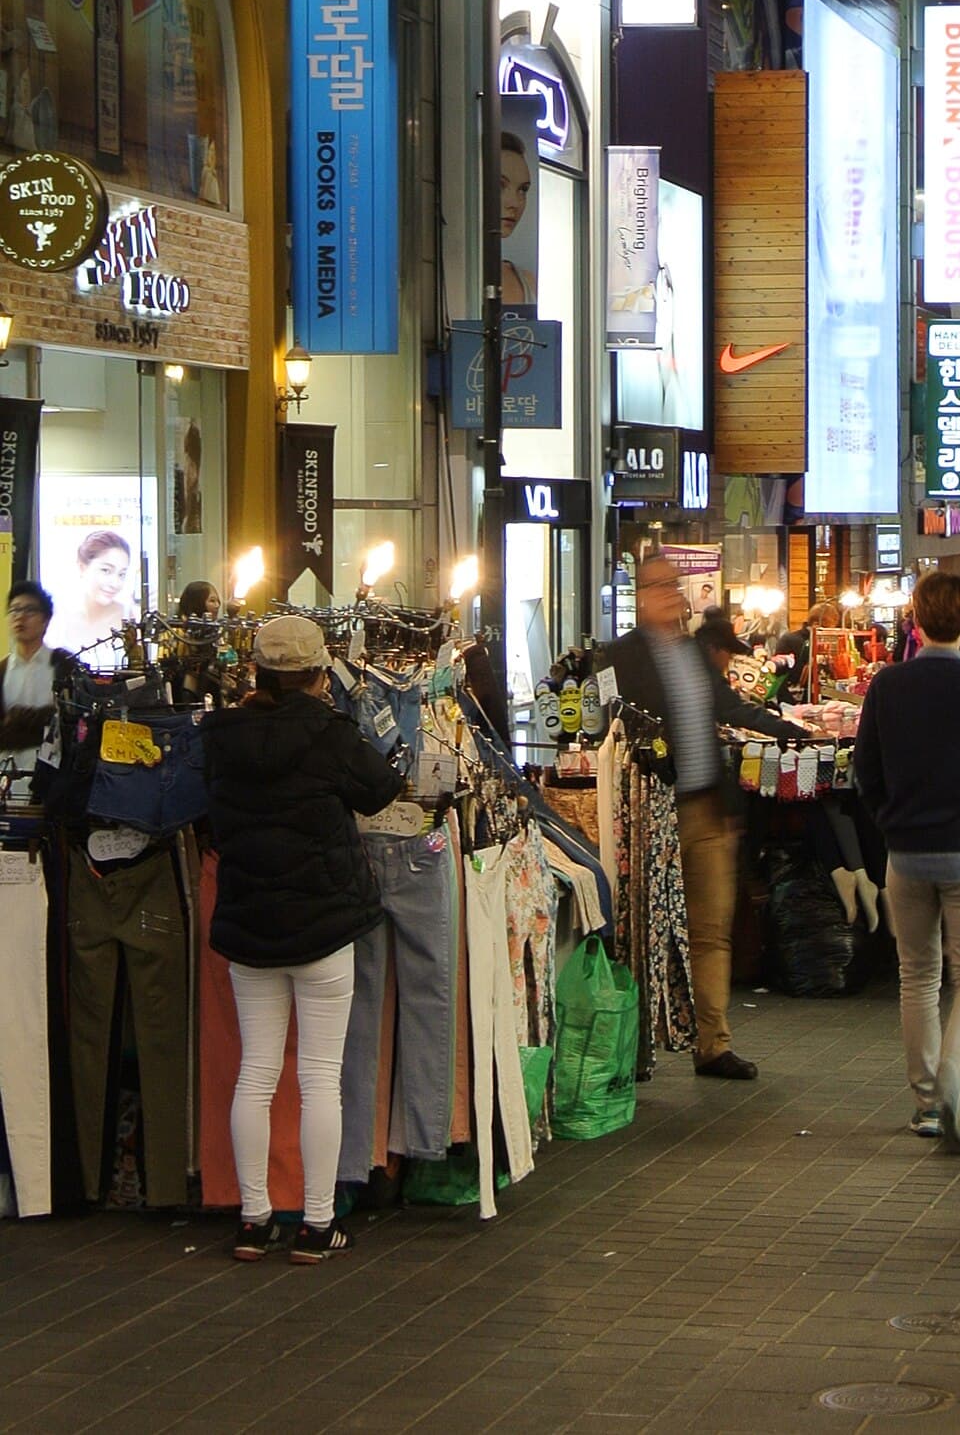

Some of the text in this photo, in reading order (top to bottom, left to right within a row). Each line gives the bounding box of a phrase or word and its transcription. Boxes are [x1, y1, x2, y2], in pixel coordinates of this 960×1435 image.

[9, 177, 54, 201] SKIN
[40, 194, 76, 206] FOOD
[632, 167, 649, 250] Brightening
[316, 131, 335, 319] BOOKS & MEDIA
[126, 270, 191, 315] FOOD
[95, 318, 132, 344] since
[465, 393, 540, 417] 바로딸
[0, 430, 18, 521] SKINFOO
[626, 448, 665, 471] ALO
[683, 450, 709, 509] ALO
[304, 449, 318, 533] SKINFOOD
